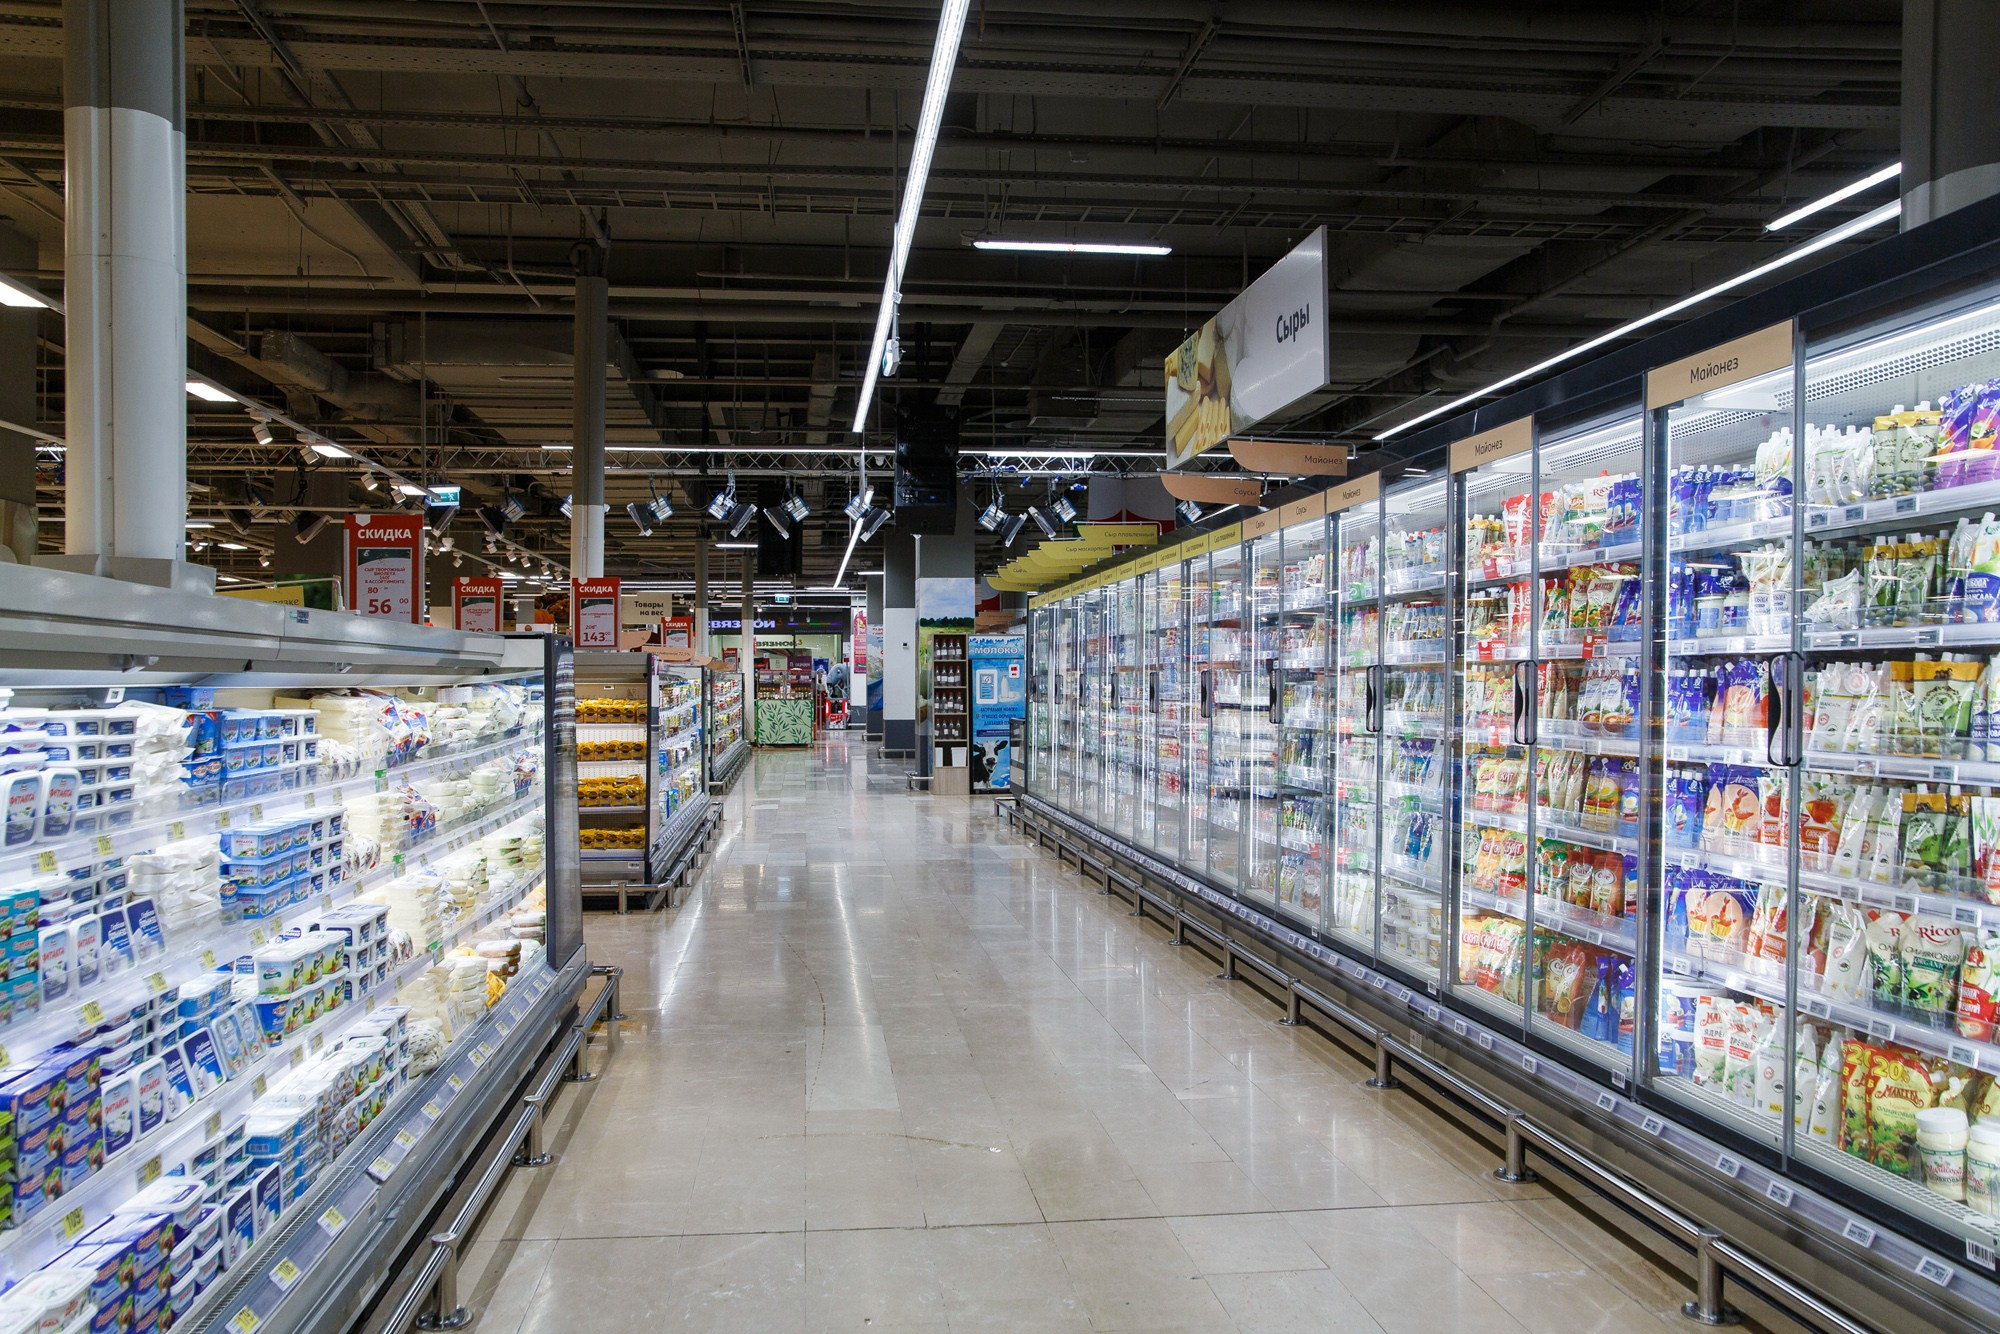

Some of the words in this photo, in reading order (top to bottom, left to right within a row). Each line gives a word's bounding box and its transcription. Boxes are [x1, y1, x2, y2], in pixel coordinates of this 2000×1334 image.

[1276, 303, 1311, 344] Сыры
[1690, 355, 1740, 384] Майонез
[1475, 438, 1504, 457] Майонез
[1304, 454, 1344, 466] Майонез
[1233, 487, 1258, 498] Соусы
[1342, 488, 1361, 500] Майонез
[357, 528, 412, 541] СКИДКА
[460, 585, 496, 594] СКИДКА
[579, 585, 613, 594] СКИДКА
[368, 598, 392, 614] 56
[634, 601, 664, 609] Товары
[708, 618, 776, 628] ВЯЗОЙ
[583, 631, 606, 642] 143
[974, 646, 1018, 654] МОЛОКО
[1704, 1028, 1724, 1038] ЯДРЁ
